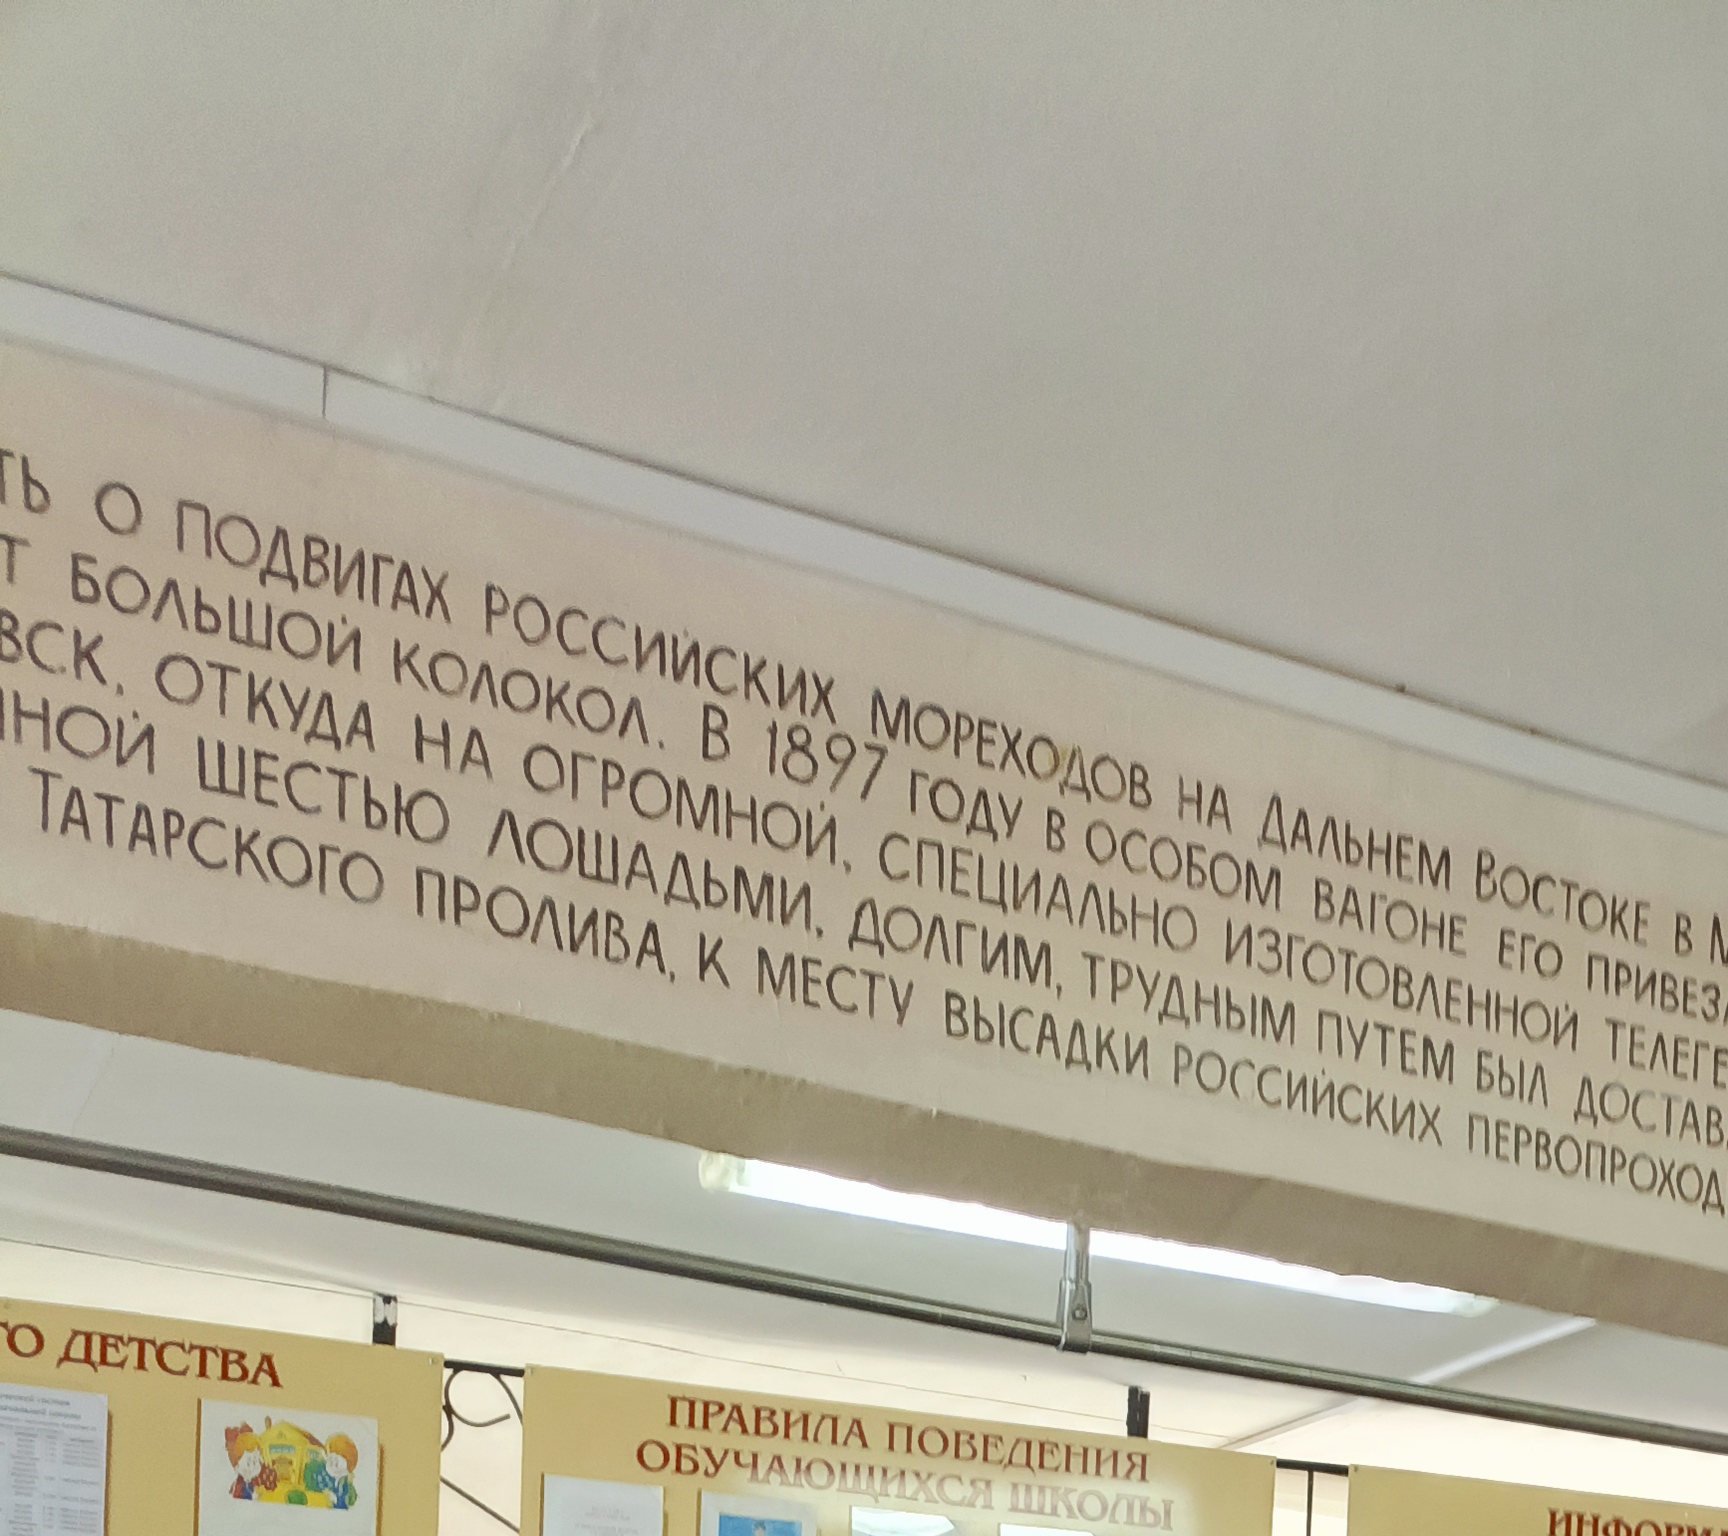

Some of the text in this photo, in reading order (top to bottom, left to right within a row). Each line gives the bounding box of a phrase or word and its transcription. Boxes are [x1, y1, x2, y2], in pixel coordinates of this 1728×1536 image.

[0, 533, 31, 585] Т
[71, 552, 362, 674] БОЛЬШОЙ
[702, 707, 731, 762] В
[767, 719, 888, 801] 1897
[909, 769, 1023, 843] ГОДУ
[1047, 807, 1066, 852] В
[1086, 820, 1281, 911] ОСОБОМ
[1312, 876, 1467, 956] ВАГОНЕ
[1498, 927, 1562, 979] ЕГО
[0, 686, 155, 775] НОЙ
[198, 735, 449, 844] ШЕСТЬЮ
[1081, 952, 1296, 1048] ТРУДНЫМ
[1317, 1009, 1454, 1086] ПУТЕМ
[1476, 1049, 1548, 1108] БЫЛ
[95, 481, 142, 535] О
[177, 499, 451, 623] ПОДВИГАХ
[485, 581, 836, 725] РОССИЙСКИХ
[870, 687, 1152, 809] МОРЕХОДОВ
[1178, 775, 1232, 835] НА
[1257, 792, 1452, 893] ДАЛЬНЕМ
[1476, 847, 1650, 947] ВОСТОКЕ
[1675, 912, 1693, 956] В
[155, 652, 376, 753] ОТКУДА
[415, 713, 493, 783] НА
[879, 831, 1197, 952] СПЕЦИАЛЬНО
[1225, 916, 1577, 1054] ИЗГОТОВЛЕННОЙ
[29, 764, 384, 905] ТАТАРСКОГО
[698, 932, 731, 990] К
[757, 946, 914, 1027] МЕСТУ
[944, 989, 1149, 1081] ВЫСАДКИ
[1172, 1041, 1443, 1147] РОССИЙСКИХ
[0, 1321, 283, 1388] О ДЕТСТВА
[636, 1438, 1174, 1531] ОБУЧАЮЩИХСЯ ШКОЛЫ
[667, 1395, 1151, 1483] ПРАВИЛА ПОВЕДЕНИЯ
